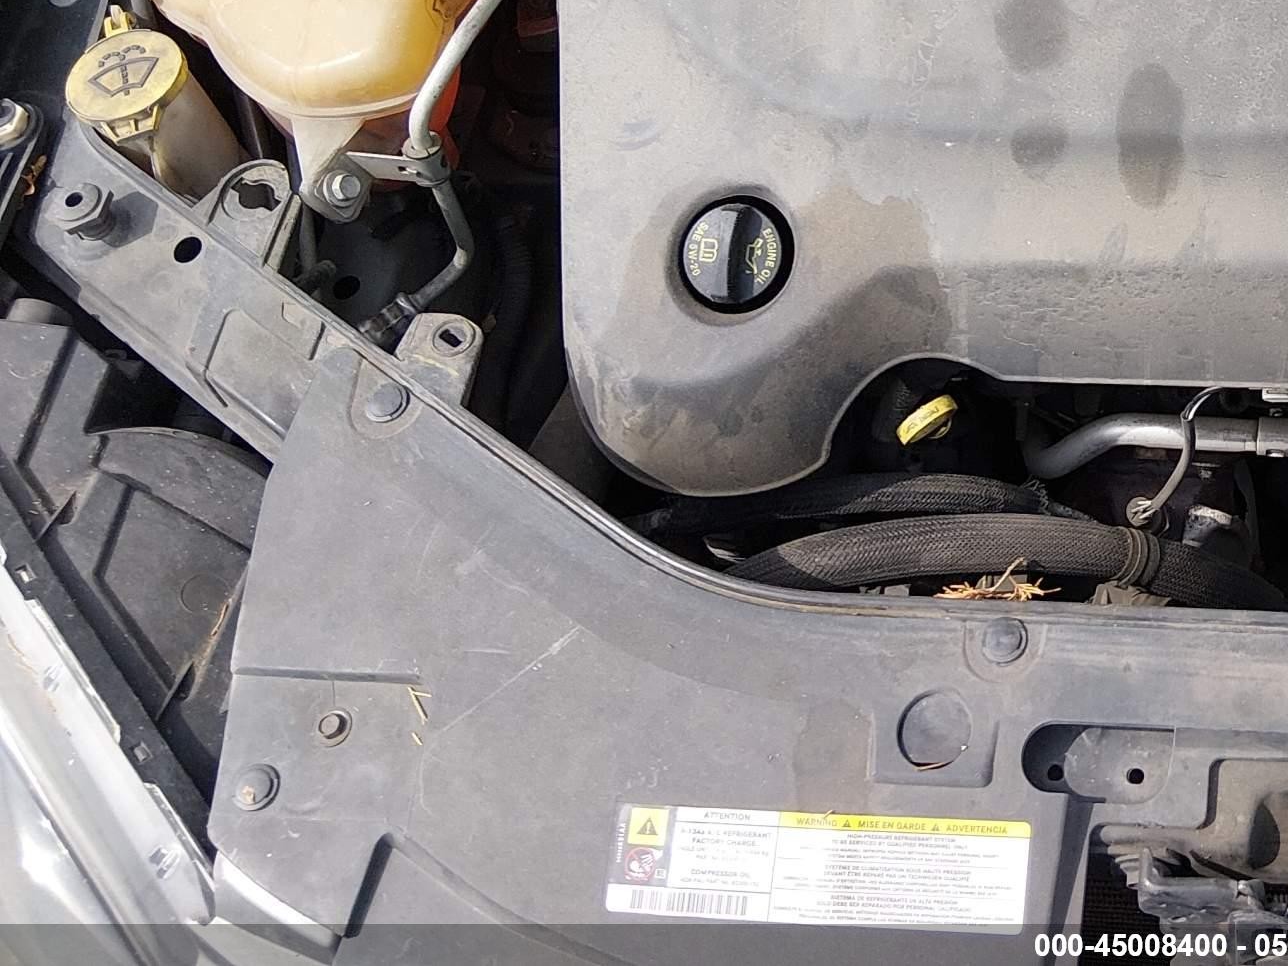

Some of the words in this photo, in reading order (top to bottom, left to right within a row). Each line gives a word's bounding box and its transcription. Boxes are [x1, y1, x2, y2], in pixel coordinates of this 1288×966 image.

[693, 220, 709, 242] SAE
[762, 227, 778, 269] ENGINE
[754, 268, 772, 285] OIL
[704, 811, 751, 821] ATTENTION
[797, 817, 837, 827] WARNING
[858, 820, 880, 829] MISE
[896, 821, 926, 831] GARDE
[946, 824, 1008, 834] ADVERTENCIA
